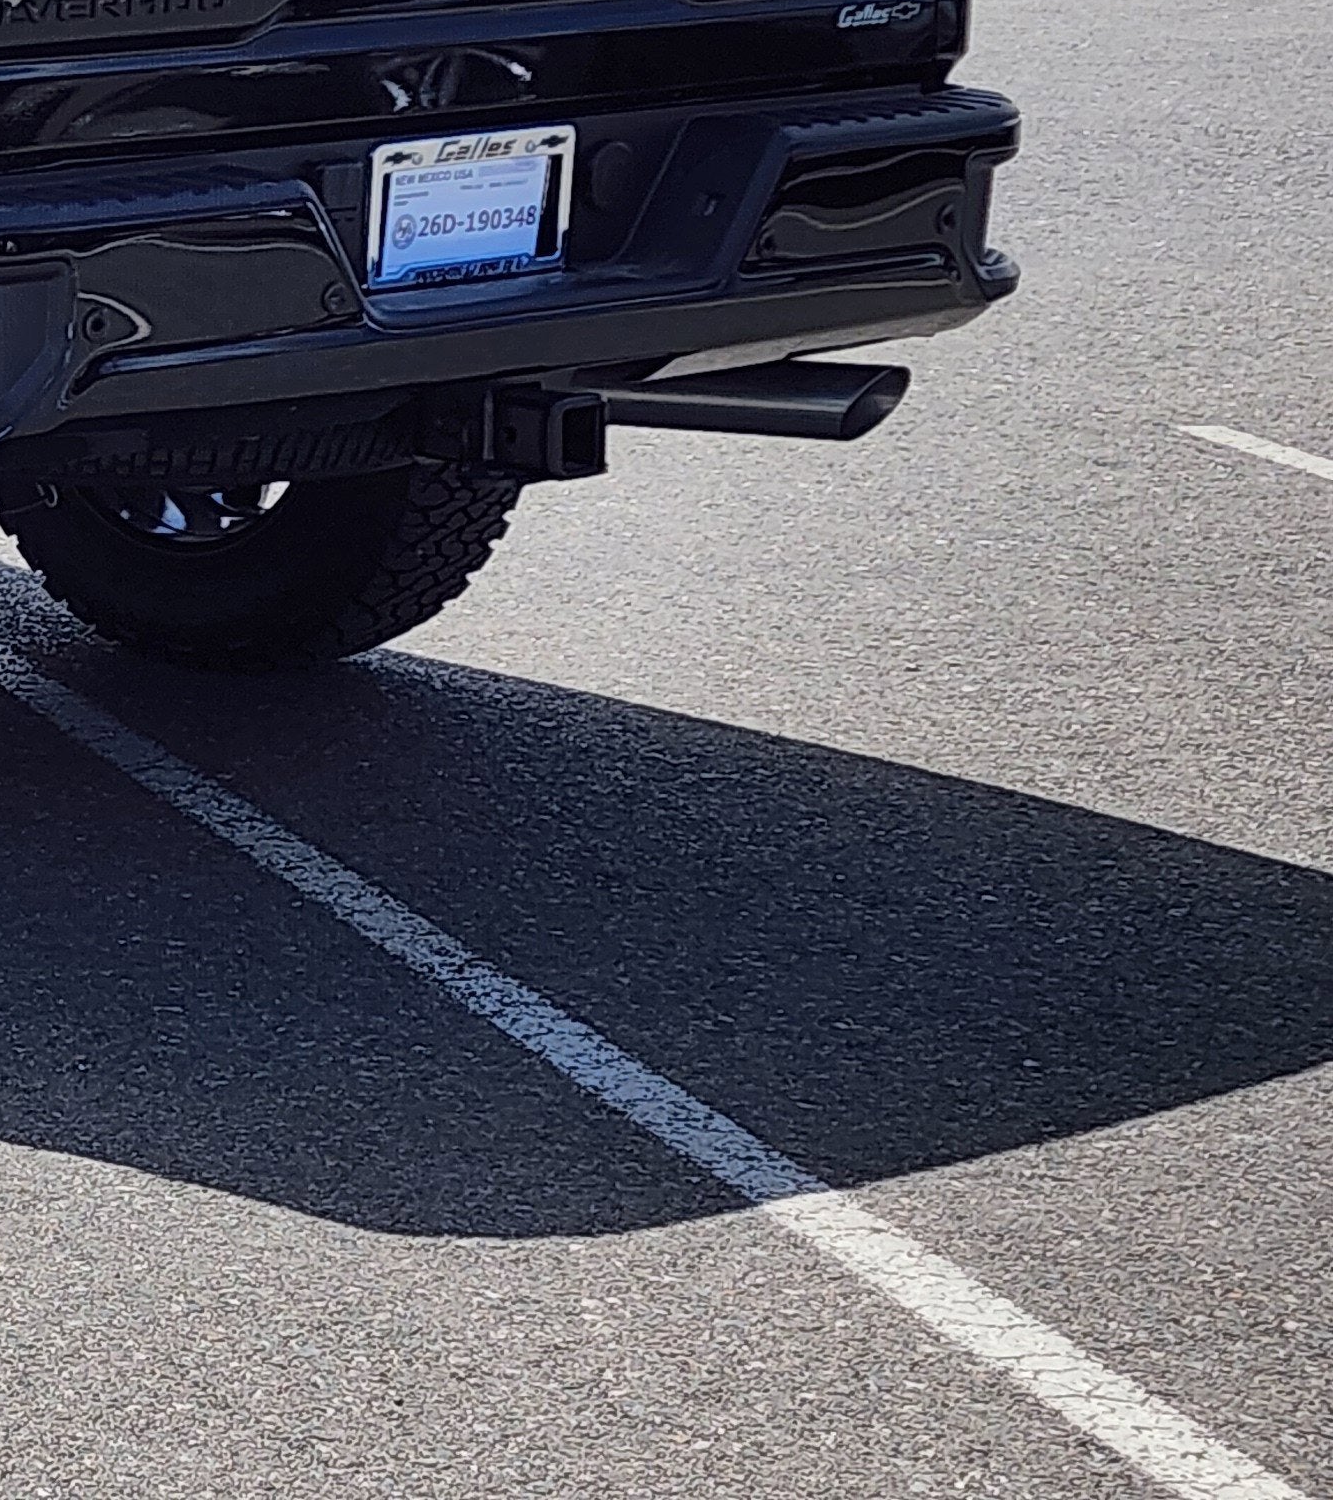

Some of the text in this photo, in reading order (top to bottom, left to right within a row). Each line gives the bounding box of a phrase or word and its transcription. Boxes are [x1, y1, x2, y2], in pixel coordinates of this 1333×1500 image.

[434, 136, 518, 164] Galles
[395, 168, 474, 186] NEW MEXICO USA
[417, 205, 538, 238] 26D-190348
